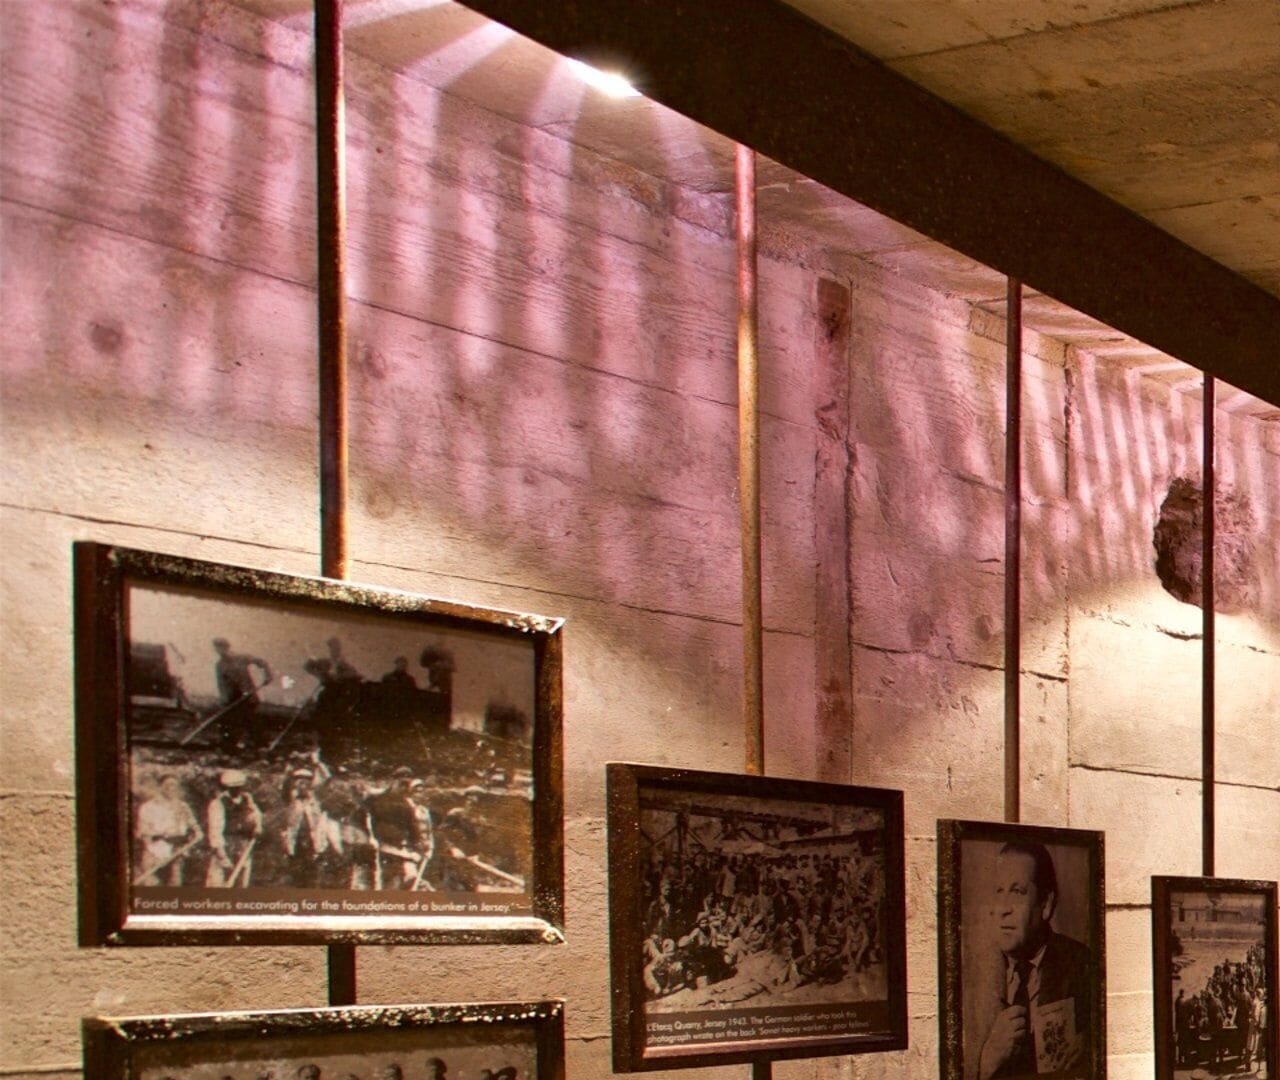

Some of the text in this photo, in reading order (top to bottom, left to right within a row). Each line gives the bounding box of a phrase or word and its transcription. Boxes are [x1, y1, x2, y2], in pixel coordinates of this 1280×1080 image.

[134, 897, 179, 910] Forced
[183, 898, 232, 910] workers
[236, 899, 299, 912] excavating
[301, 899, 318, 911] for
[321, 900, 340, 911] the
[342, 900, 406, 912] foundations
[408, 901, 420, 912] of
[421, 904, 429, 912] a
[431, 901, 465, 912] bunker
[468, 902, 478, 912] in
[704, 1019, 727, 1029] Jersey
[750, 1015, 763, 1025] The
[764, 1015, 792, 1024] German
[646, 1033, 691, 1045] photograph
[715, 1031, 726, 1039] on
[726, 1029, 739, 1037] the
[740, 1027, 757, 1037] back
